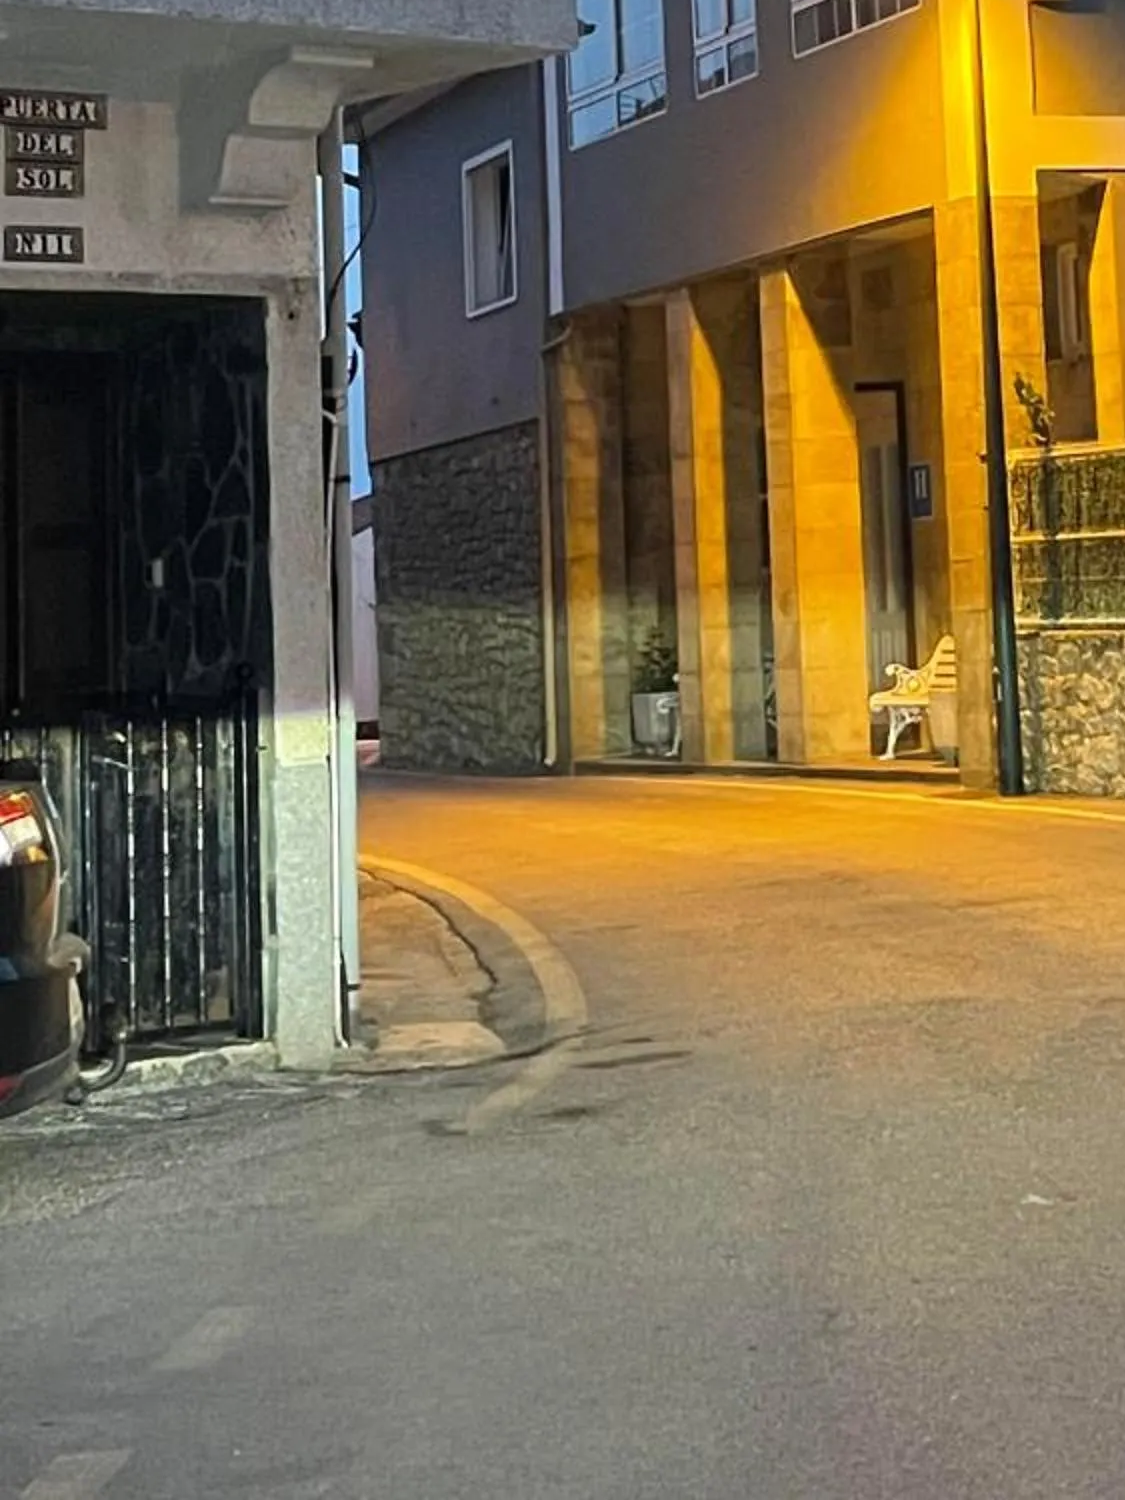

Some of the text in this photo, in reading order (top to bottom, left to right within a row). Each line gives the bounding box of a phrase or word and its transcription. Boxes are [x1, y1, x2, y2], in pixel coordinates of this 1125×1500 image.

[0, 97, 94, 121] PUERTA
[20, 133, 71, 154] DEL
[20, 168, 71, 190] SOL
